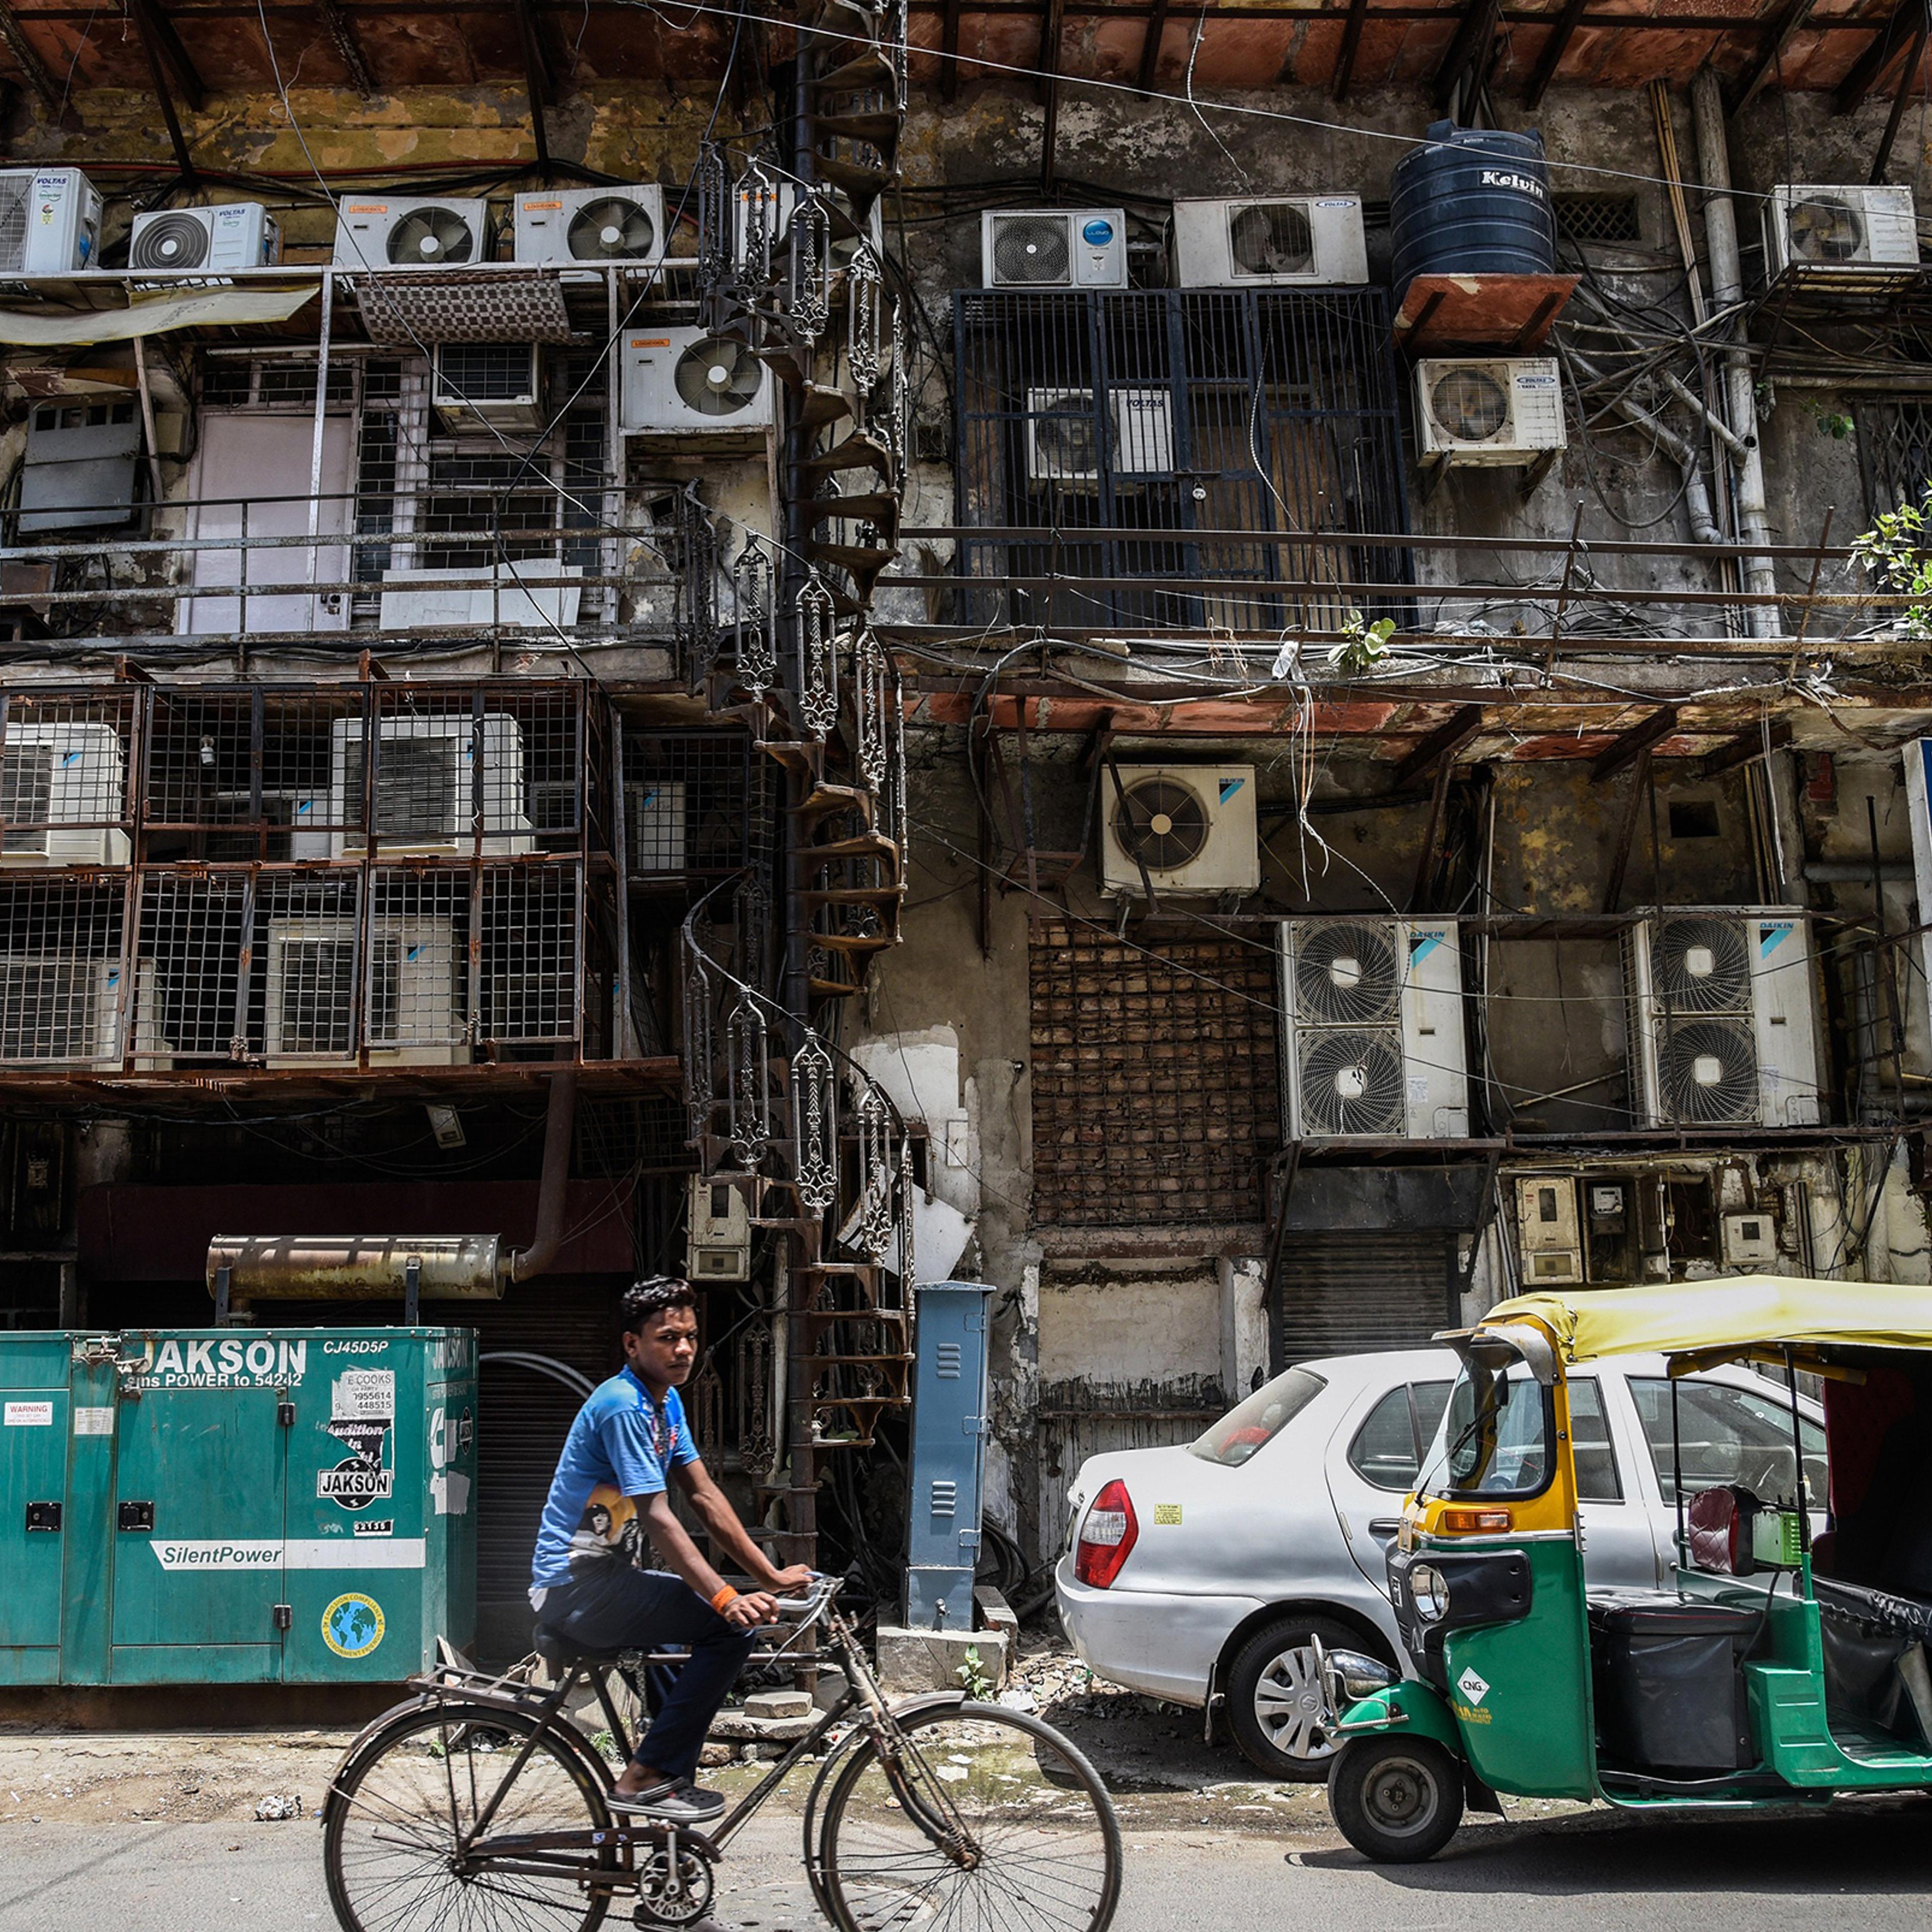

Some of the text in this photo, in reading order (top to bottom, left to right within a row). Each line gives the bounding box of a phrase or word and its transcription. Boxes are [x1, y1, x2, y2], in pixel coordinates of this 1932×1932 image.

[1481, 171, 1544, 200] Kelvin
[324, 1341, 388, 1353] CJ45D5P
[135, 1340, 306, 1374] JAKSON
[166, 1374, 229, 1387] POWER
[234, 1374, 250, 1387] to
[255, 1373, 302, 1387] 54242
[356, 1374, 391, 1385] COOKS
[323, 1474, 387, 1492] JAKSON
[163, 1547, 282, 1563] SilentPower
[1463, 1680, 1482, 1692] CNG
